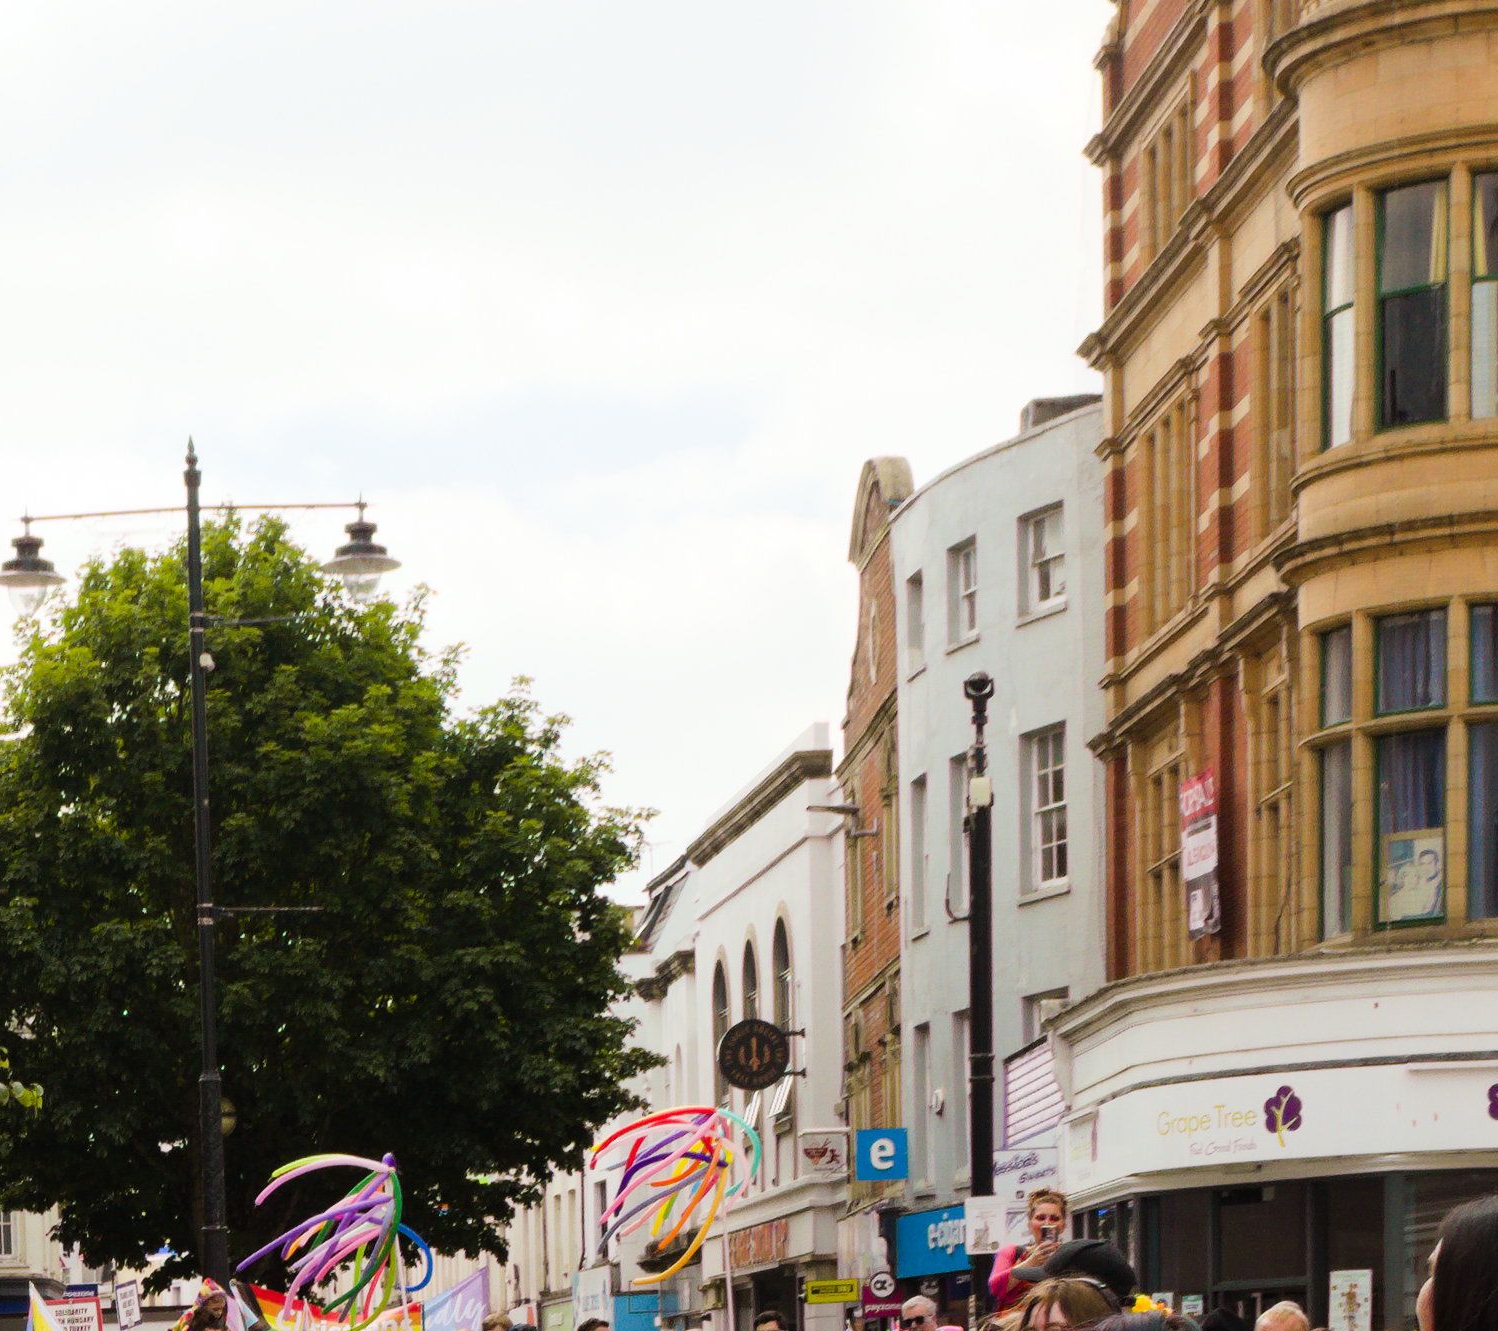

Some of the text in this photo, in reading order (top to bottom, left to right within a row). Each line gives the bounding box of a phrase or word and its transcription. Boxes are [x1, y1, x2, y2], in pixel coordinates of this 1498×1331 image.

[1157, 1104, 1258, 1136] Grape Tree
[869, 1137, 896, 1170] e
